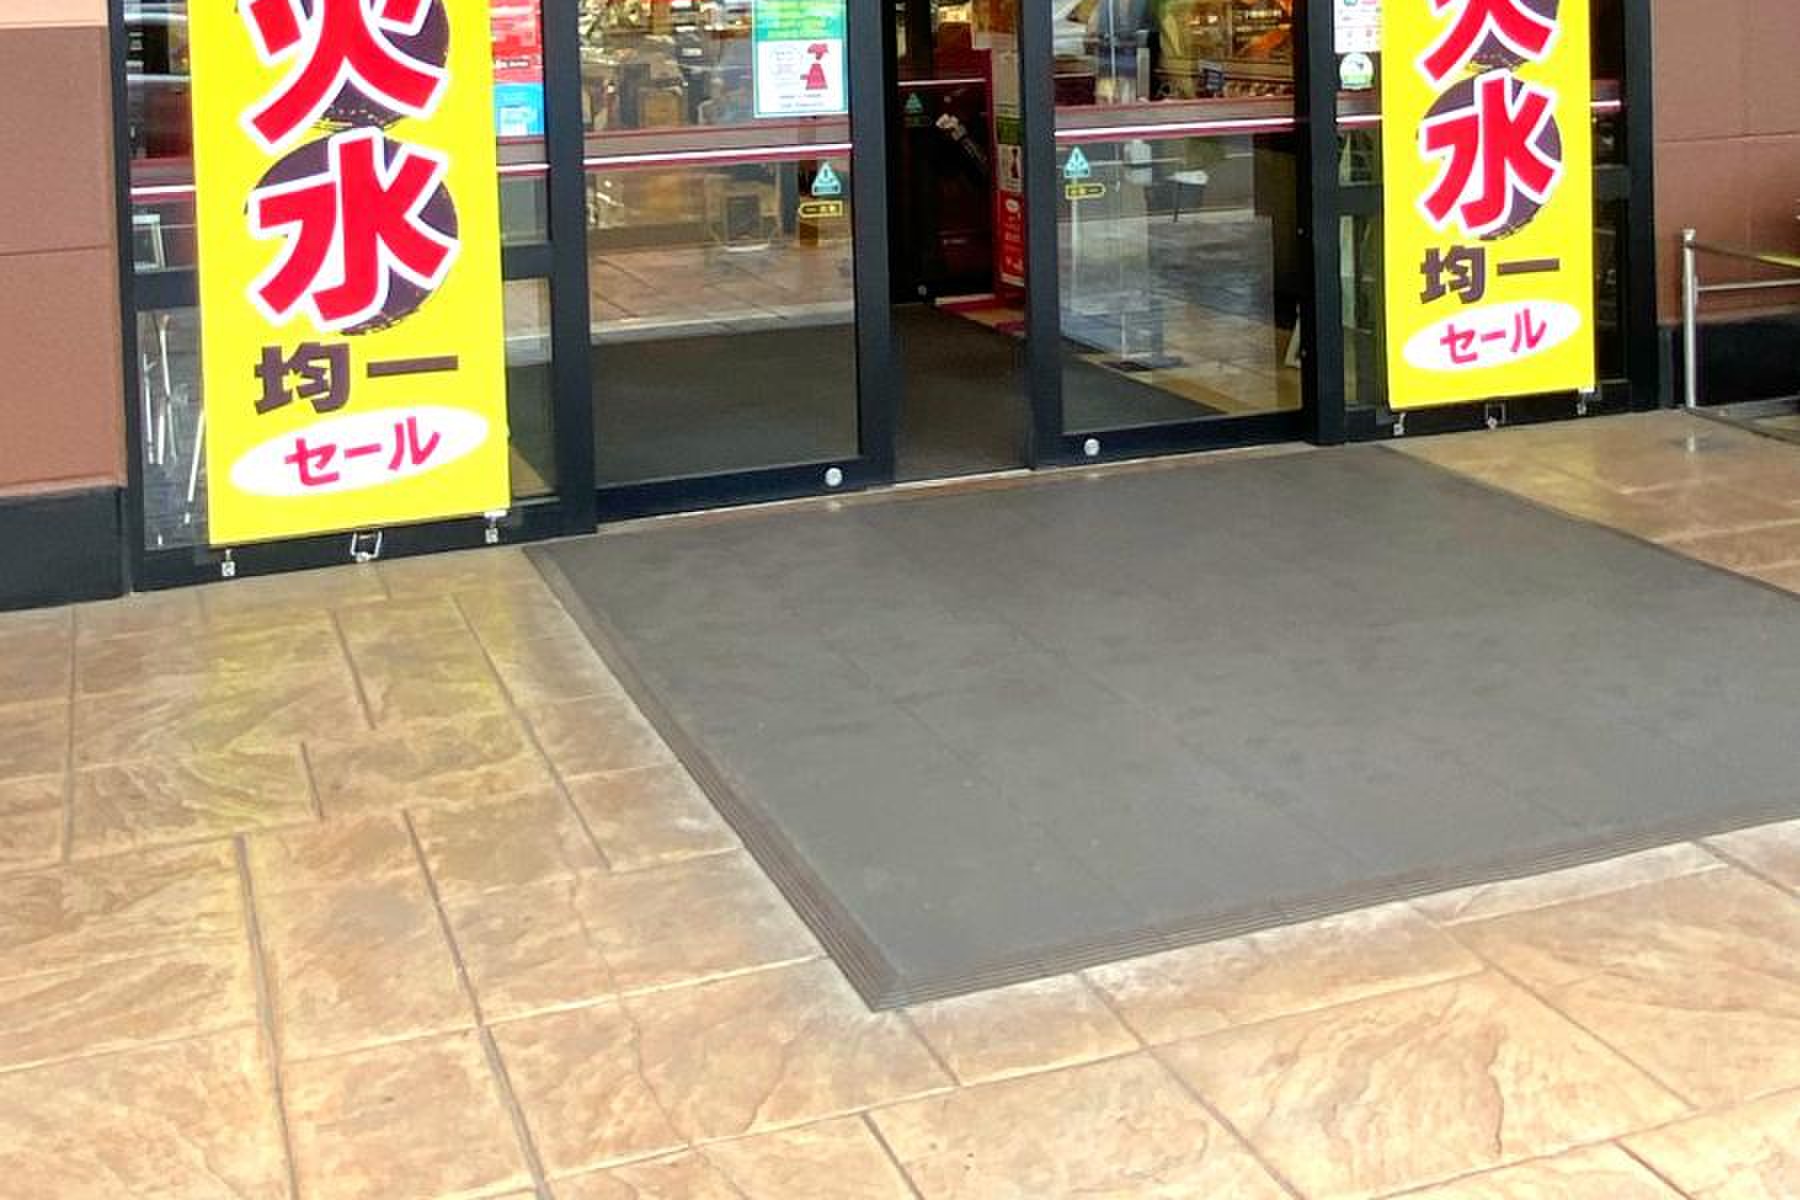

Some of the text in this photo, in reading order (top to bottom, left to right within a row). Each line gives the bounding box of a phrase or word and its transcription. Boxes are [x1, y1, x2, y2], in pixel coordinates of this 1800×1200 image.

[1419, 244, 1560, 304] 均一
[1440, 308, 1547, 364] セール
[253, 340, 460, 415] 均一
[284, 415, 442, 487] セール
